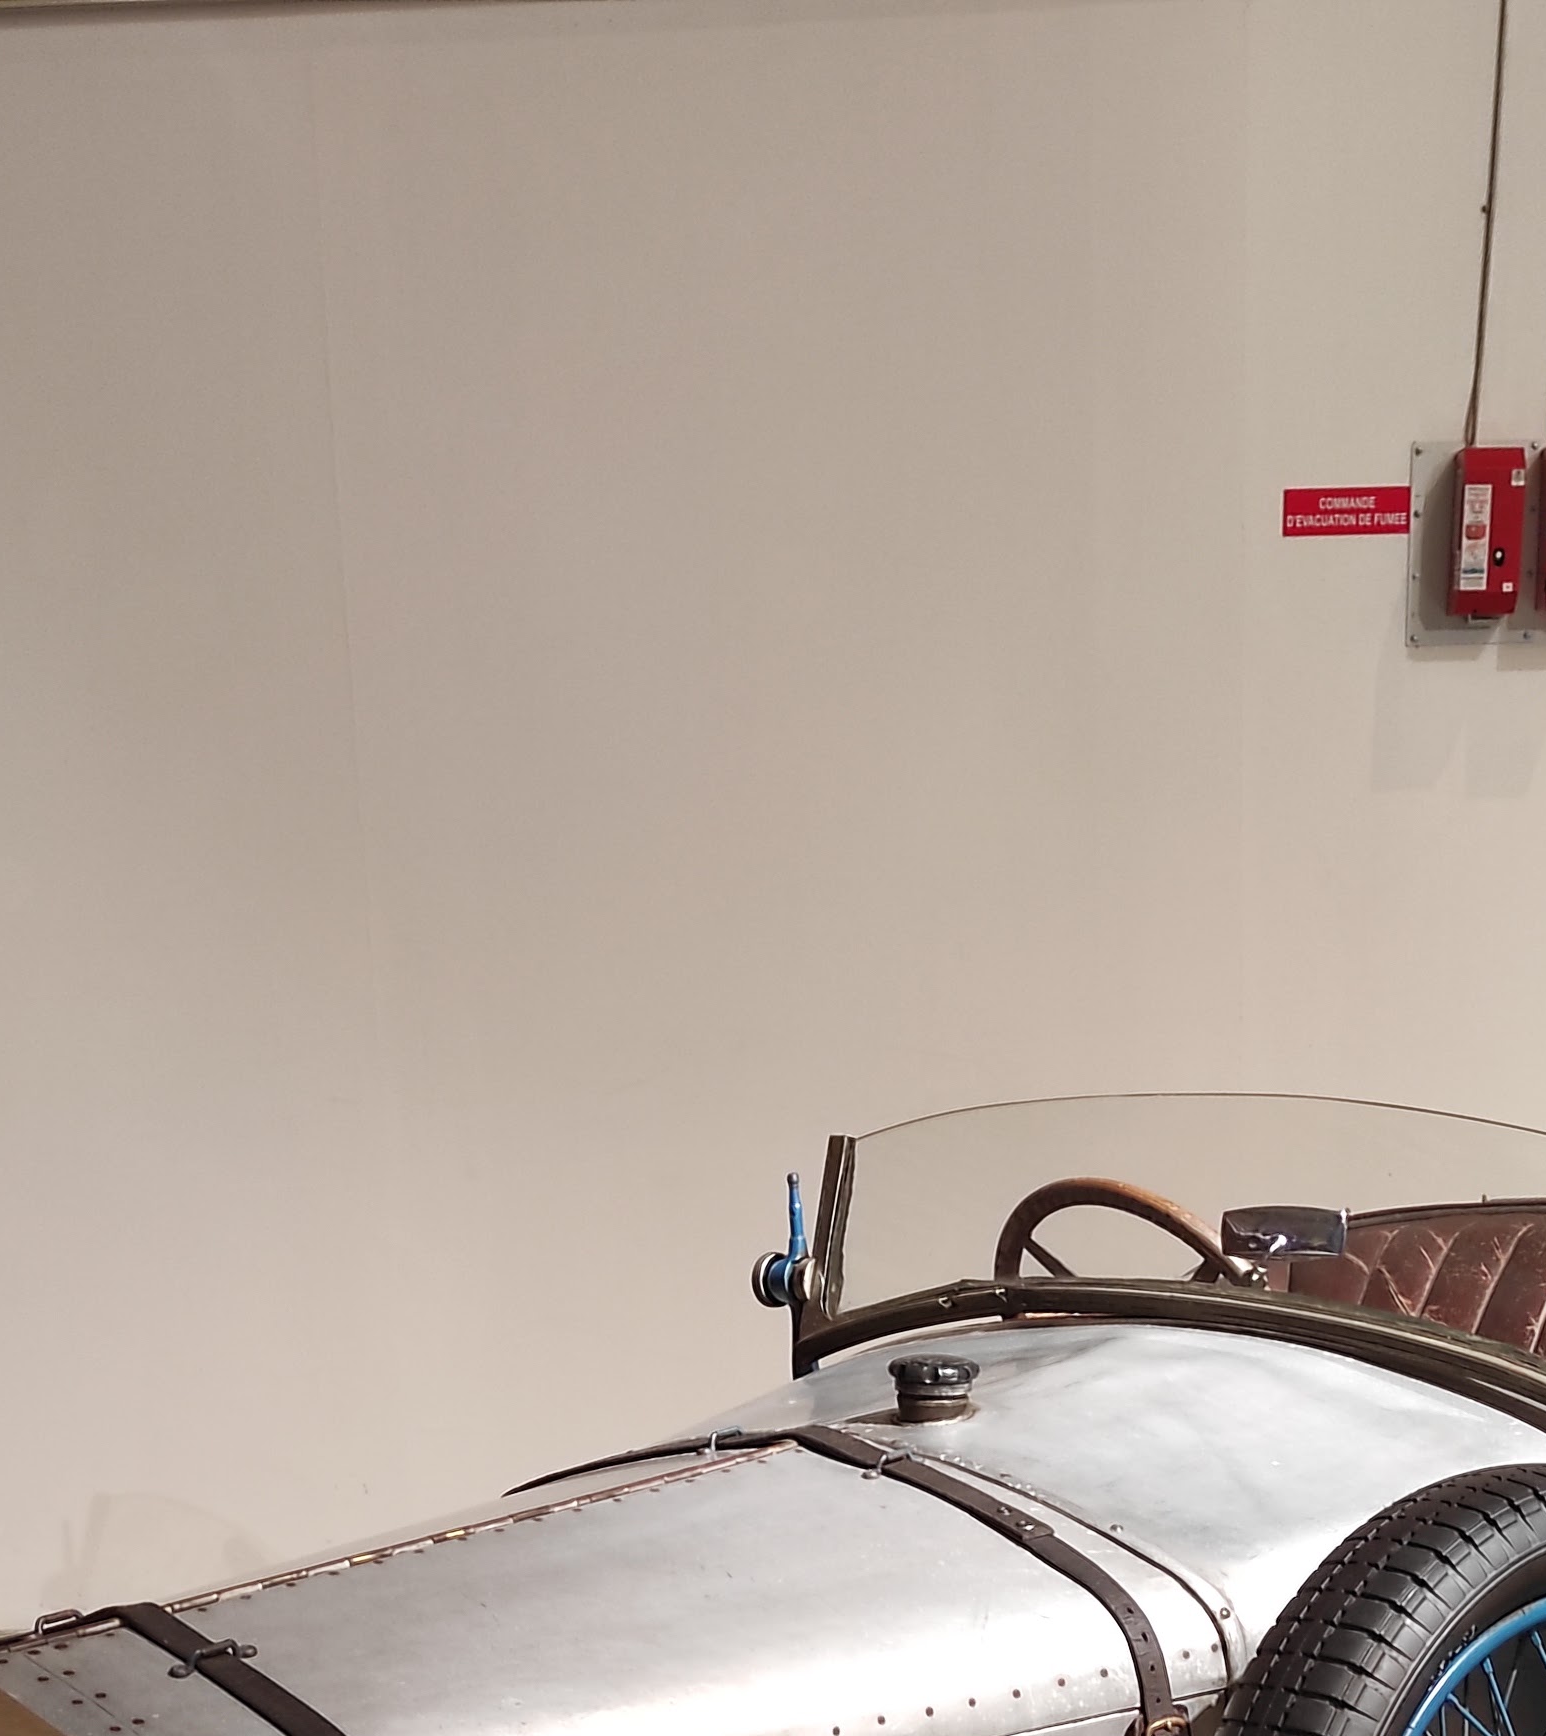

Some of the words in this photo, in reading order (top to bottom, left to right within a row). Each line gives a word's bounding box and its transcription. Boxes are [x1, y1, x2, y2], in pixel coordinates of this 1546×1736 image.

[1319, 496, 1377, 510] COMMANDE
[1358, 513, 1371, 525] DE
[1374, 512, 1407, 525] FUMEE
